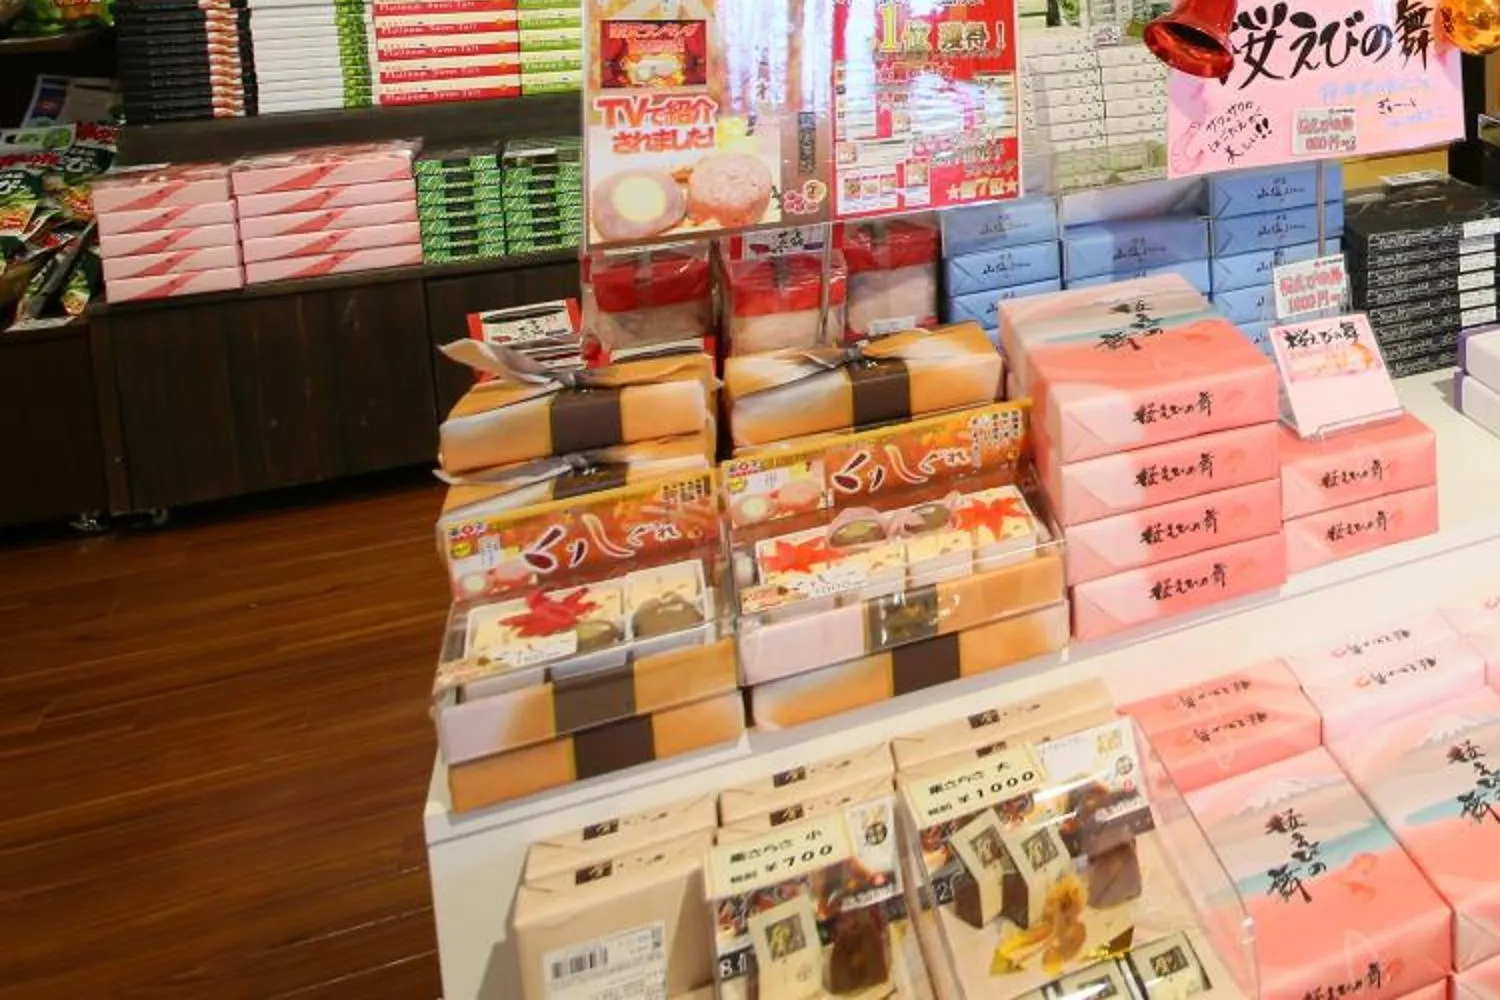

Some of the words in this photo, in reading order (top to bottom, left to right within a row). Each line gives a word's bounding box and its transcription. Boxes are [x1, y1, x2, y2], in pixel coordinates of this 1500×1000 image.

[595, 97, 717, 129] TVで紹介
[612, 128, 716, 155] されました!
